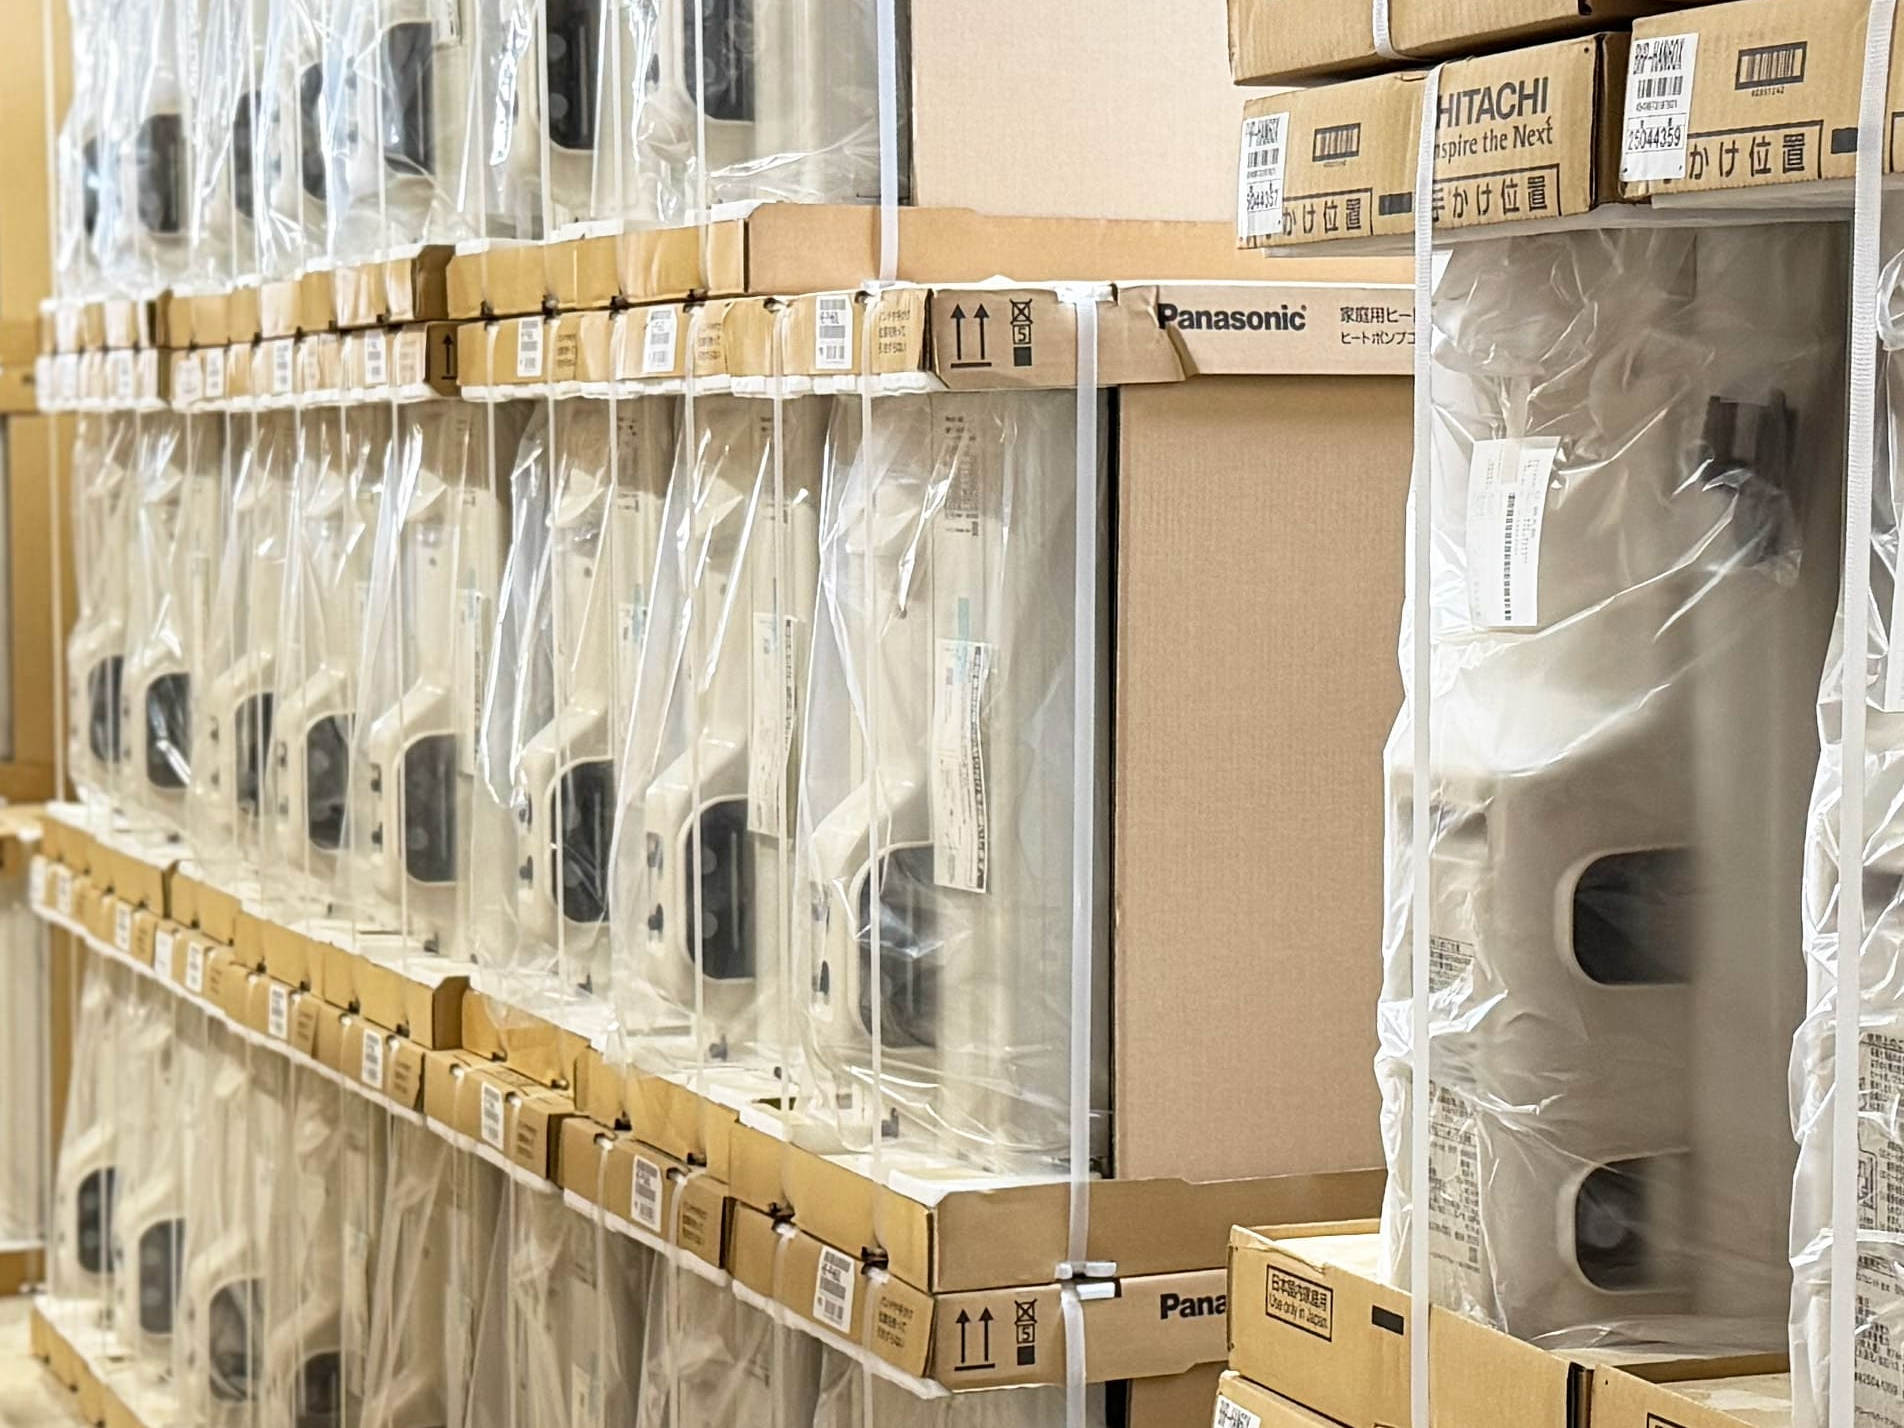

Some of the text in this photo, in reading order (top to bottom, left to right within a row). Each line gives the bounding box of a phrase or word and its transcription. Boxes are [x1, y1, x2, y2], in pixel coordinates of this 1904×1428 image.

[1482, 113, 1554, 154] the Next
[1688, 133, 1807, 181] かけ位置
[1158, 304, 1307, 332] Panasonic
